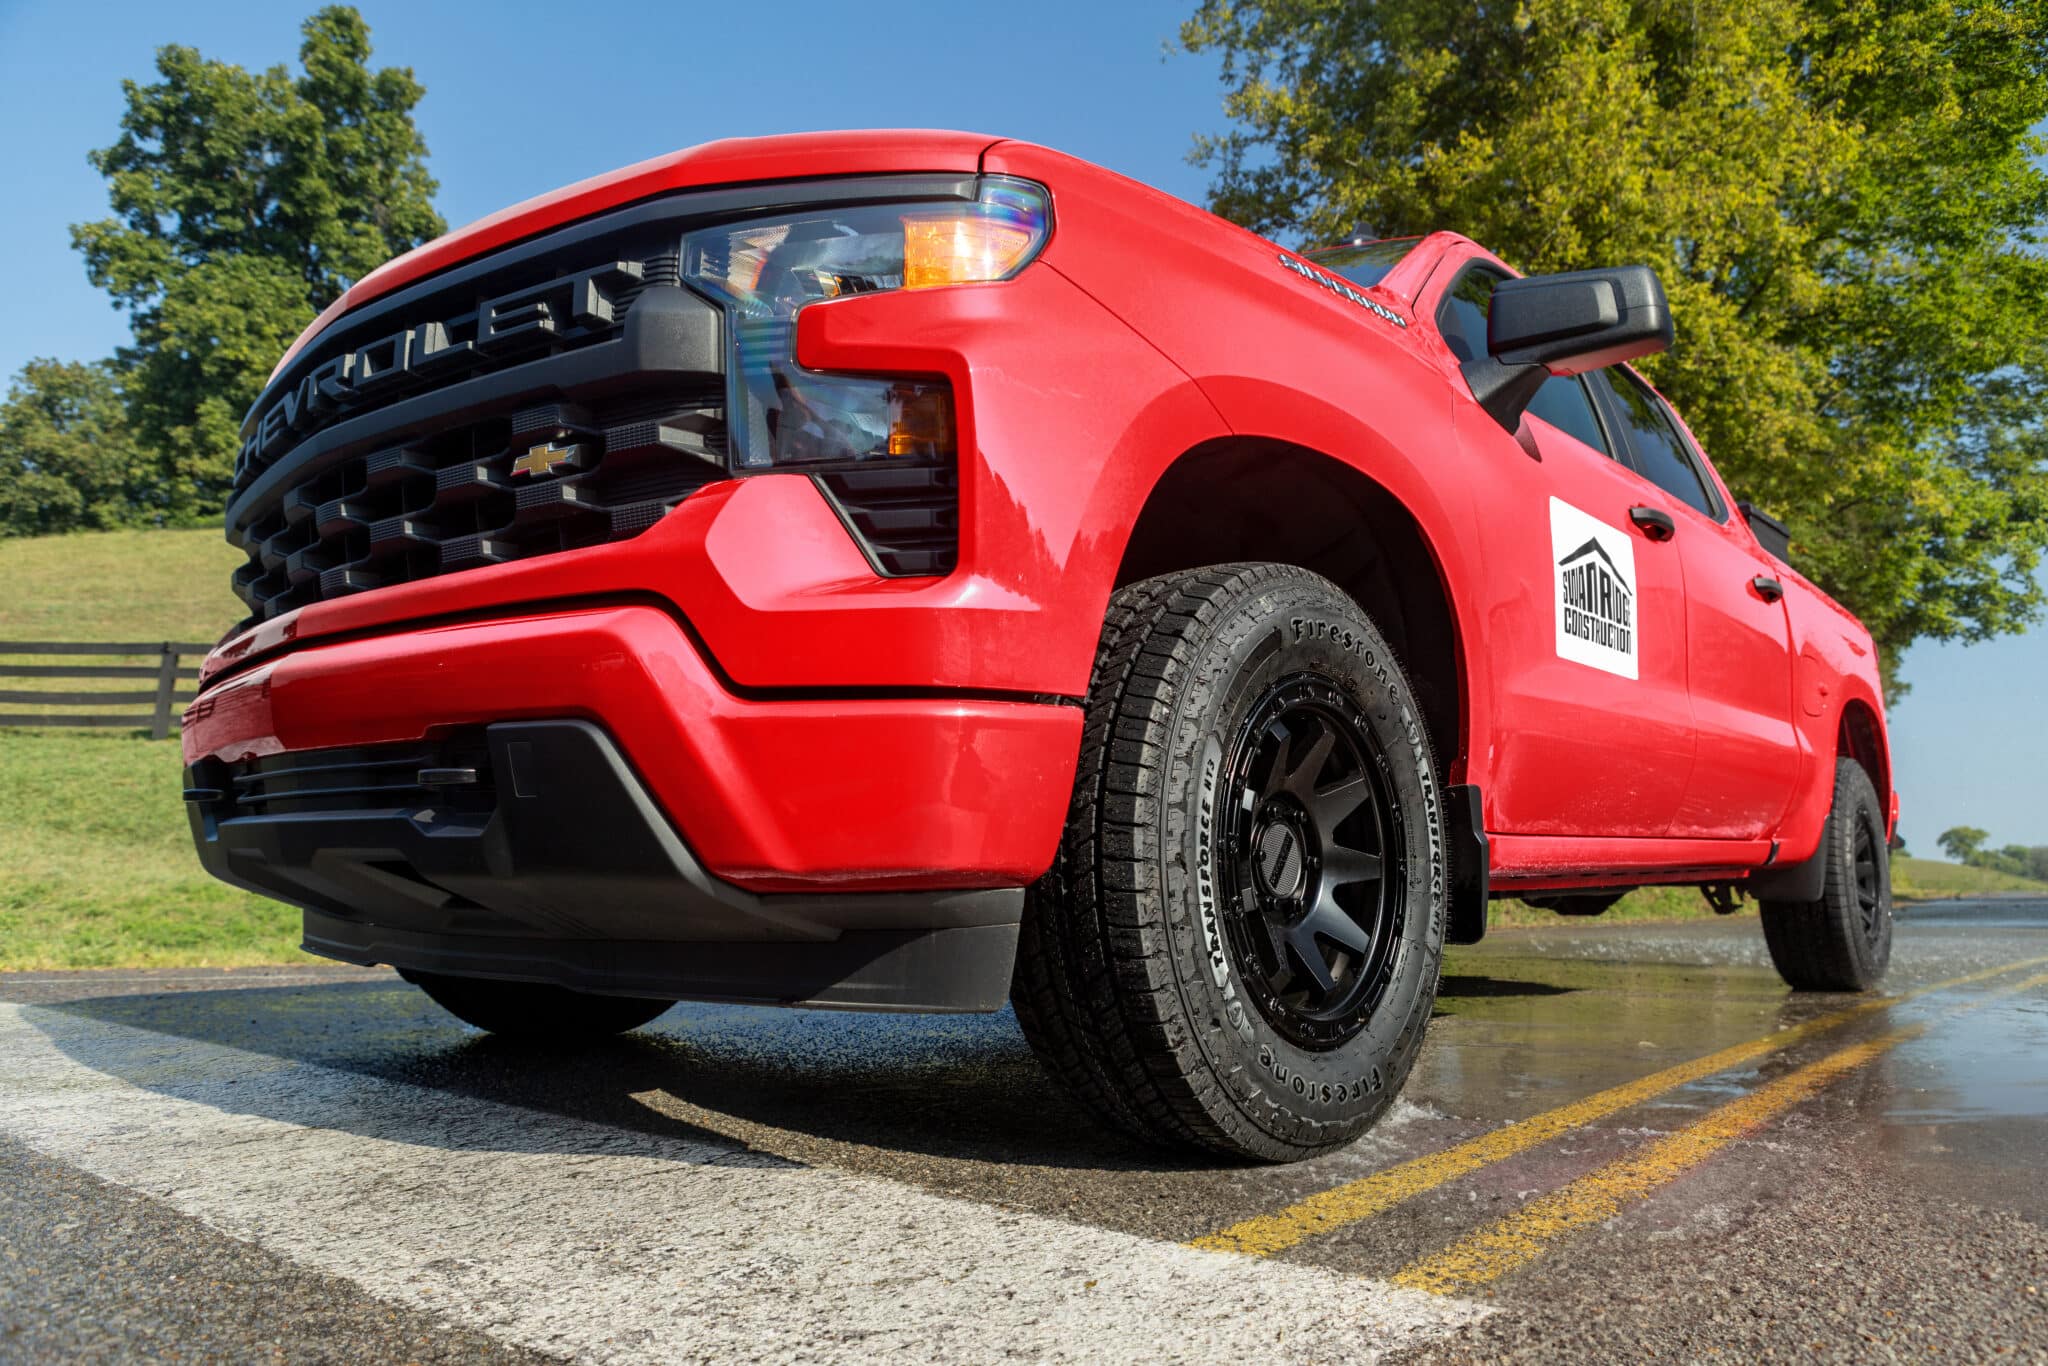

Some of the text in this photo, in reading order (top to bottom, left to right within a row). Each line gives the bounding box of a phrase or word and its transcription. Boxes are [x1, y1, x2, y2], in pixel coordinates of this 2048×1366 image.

[1290, 616, 1400, 706] Firestone
[1564, 607, 1631, 655] CONSTRUCTION
[1200, 799, 1223, 968] TRANSFORCE
[1257, 1042, 1384, 1104] Firestone
